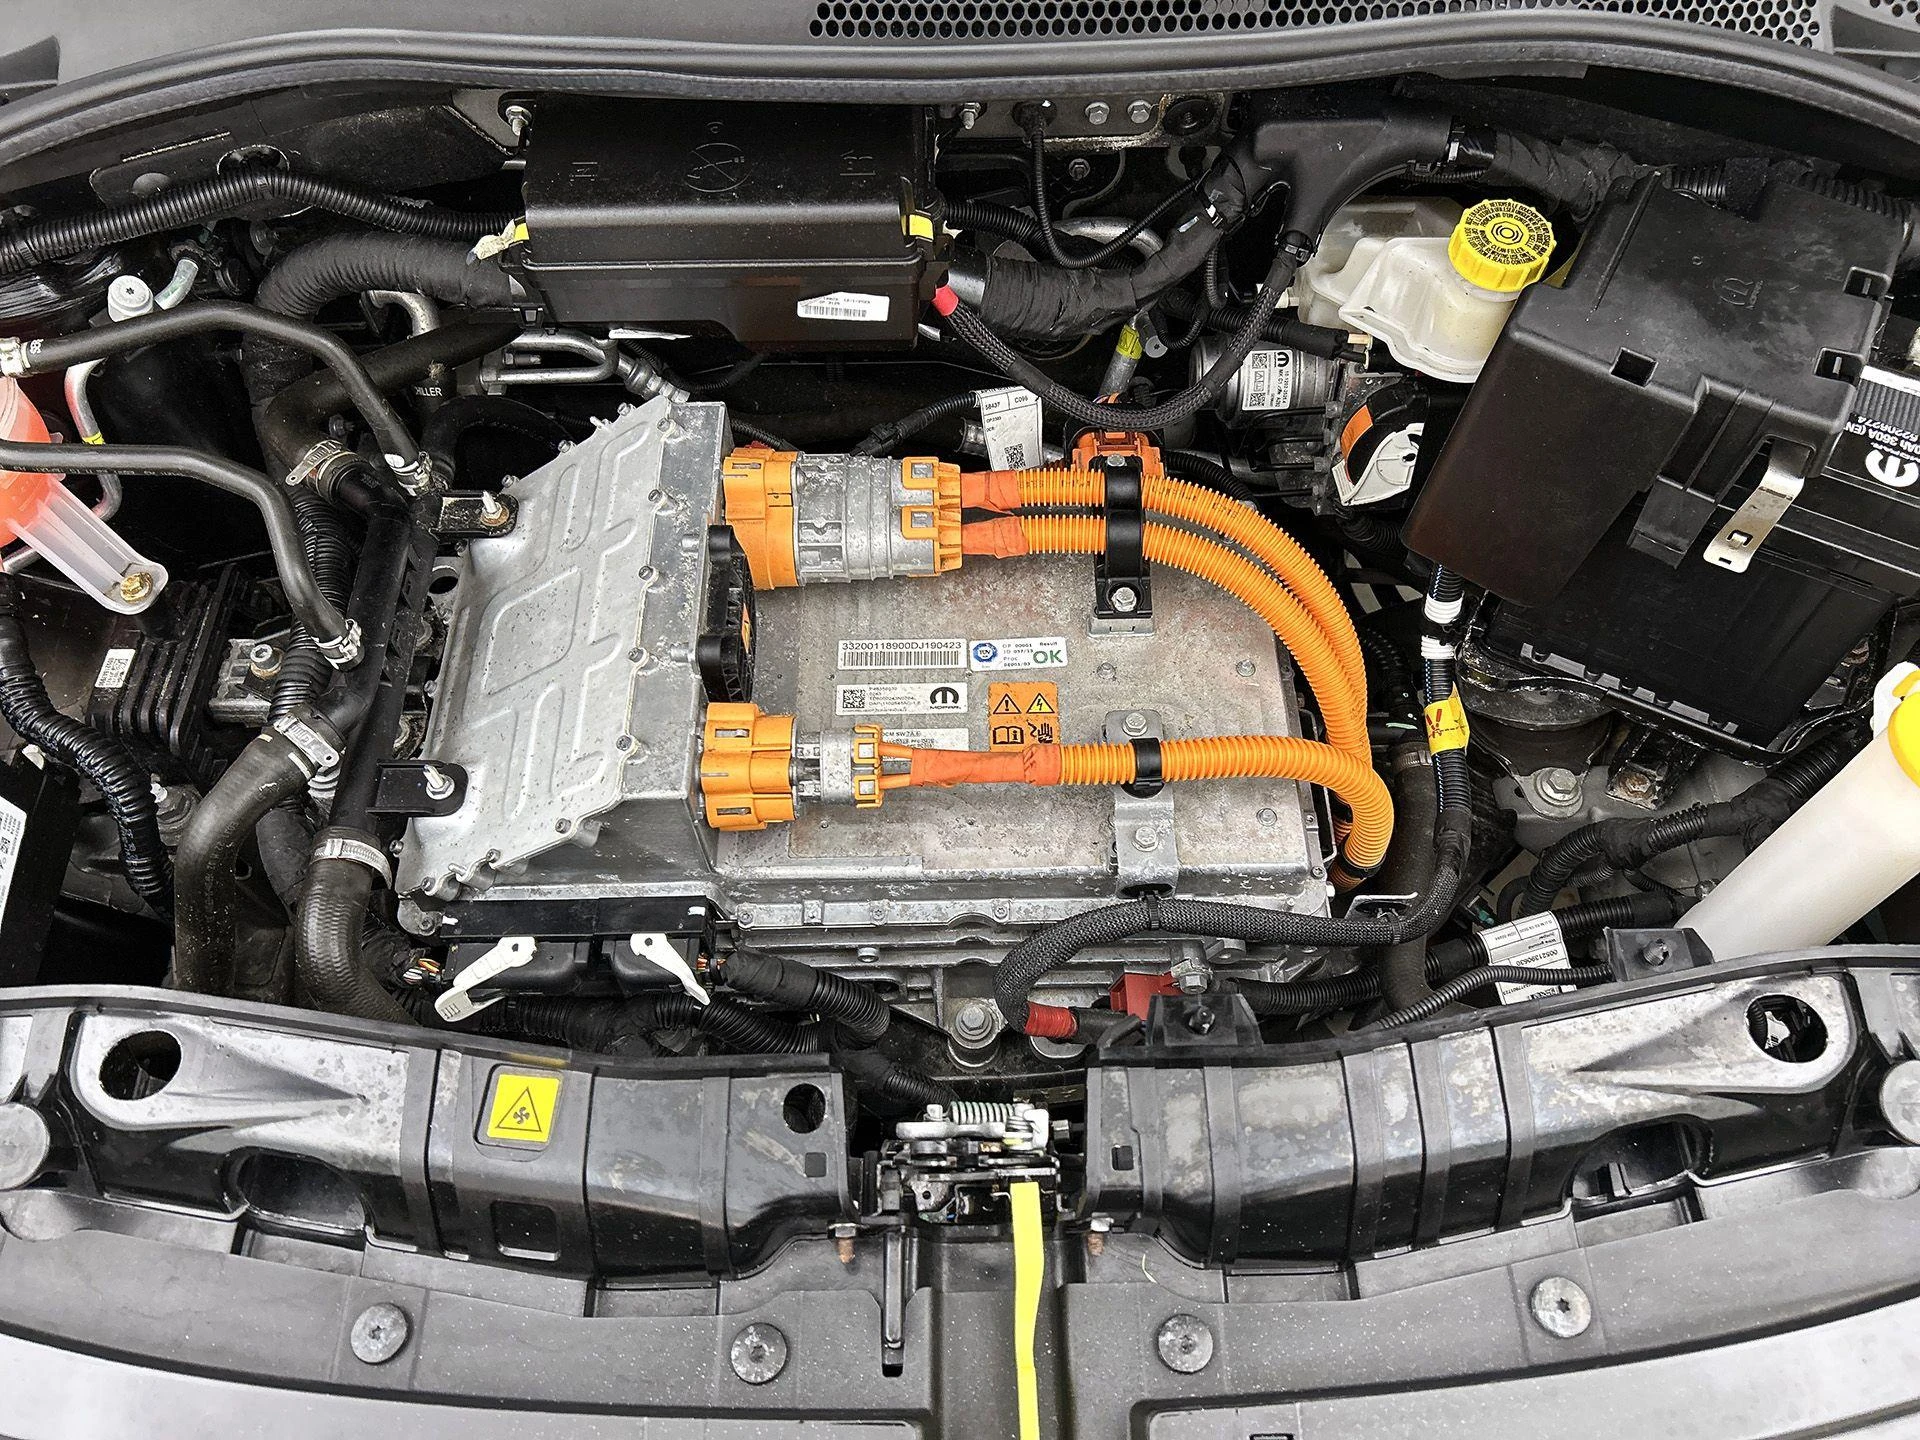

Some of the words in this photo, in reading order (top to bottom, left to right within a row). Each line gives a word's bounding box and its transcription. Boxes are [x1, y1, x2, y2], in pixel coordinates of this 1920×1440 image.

[1491, 245, 1506, 253] CLEAN
[1843, 421, 1867, 436] (EN
[1868, 428, 1898, 446] 360A
[842, 641, 961, 650] 33200118900DJ190423
[1033, 650, 1063, 664] OK
